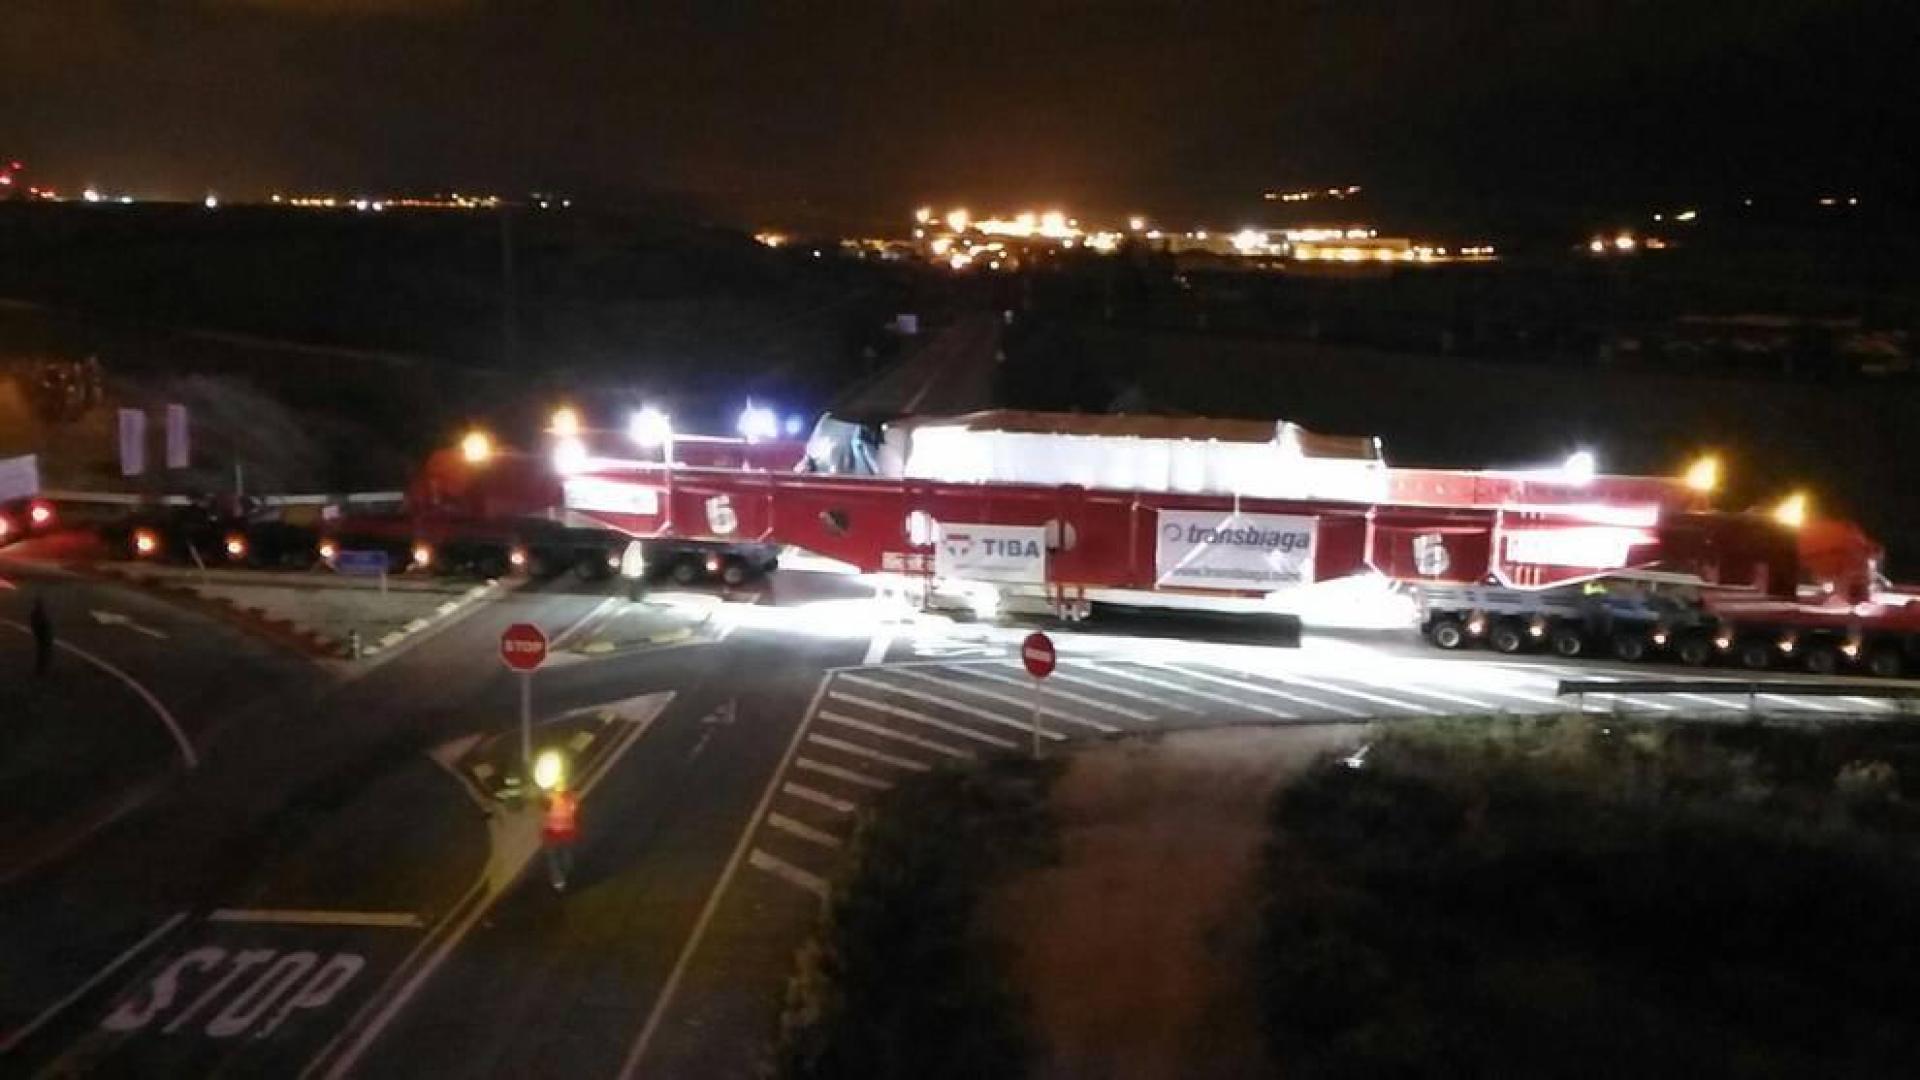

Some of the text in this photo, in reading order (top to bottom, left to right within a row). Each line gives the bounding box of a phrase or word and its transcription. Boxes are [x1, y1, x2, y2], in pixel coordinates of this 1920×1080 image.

[982, 538, 1040, 559] TIBA
[1187, 523, 1311, 553] transbiaga
[504, 640, 544, 653] STOP
[101, 946, 366, 1039] STOP
